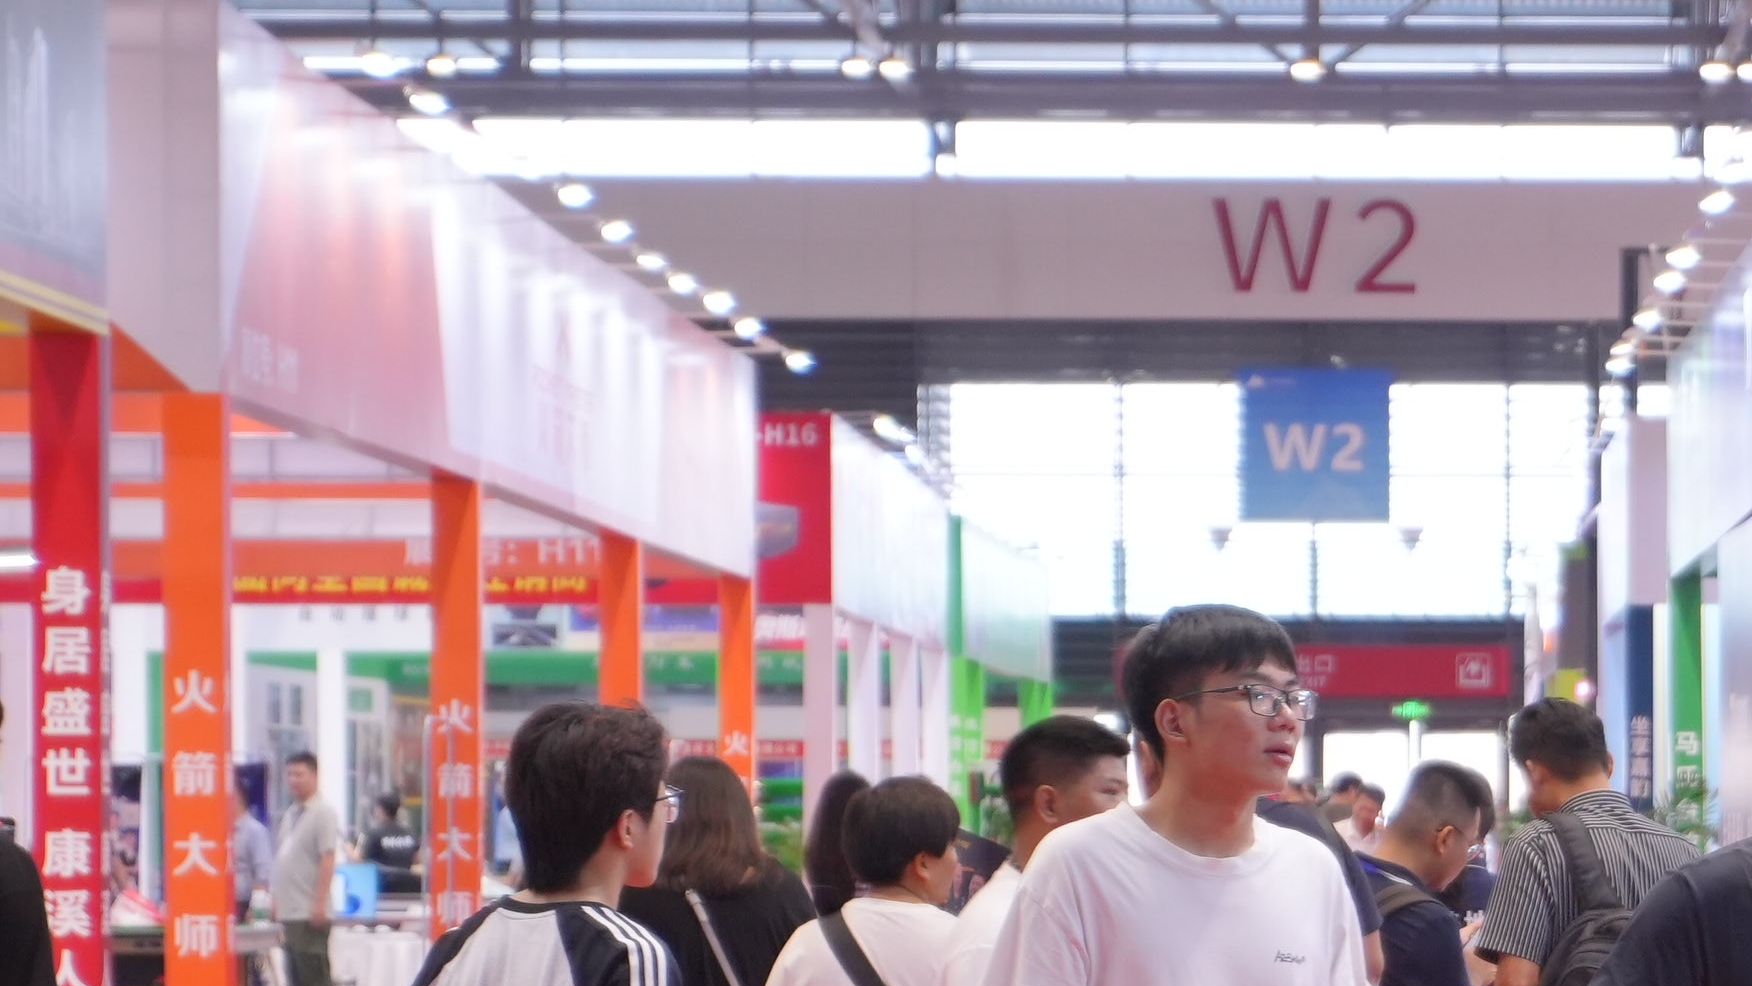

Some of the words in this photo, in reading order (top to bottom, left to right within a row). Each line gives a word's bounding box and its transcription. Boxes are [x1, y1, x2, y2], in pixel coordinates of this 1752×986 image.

[1212, 197, 1419, 296] W2
[1263, 422, 1367, 471] W2
[41, 566, 91, 796] 身居盛世
[171, 669, 220, 958] 火箭大师
[436, 698, 474, 926] 火箭大师
